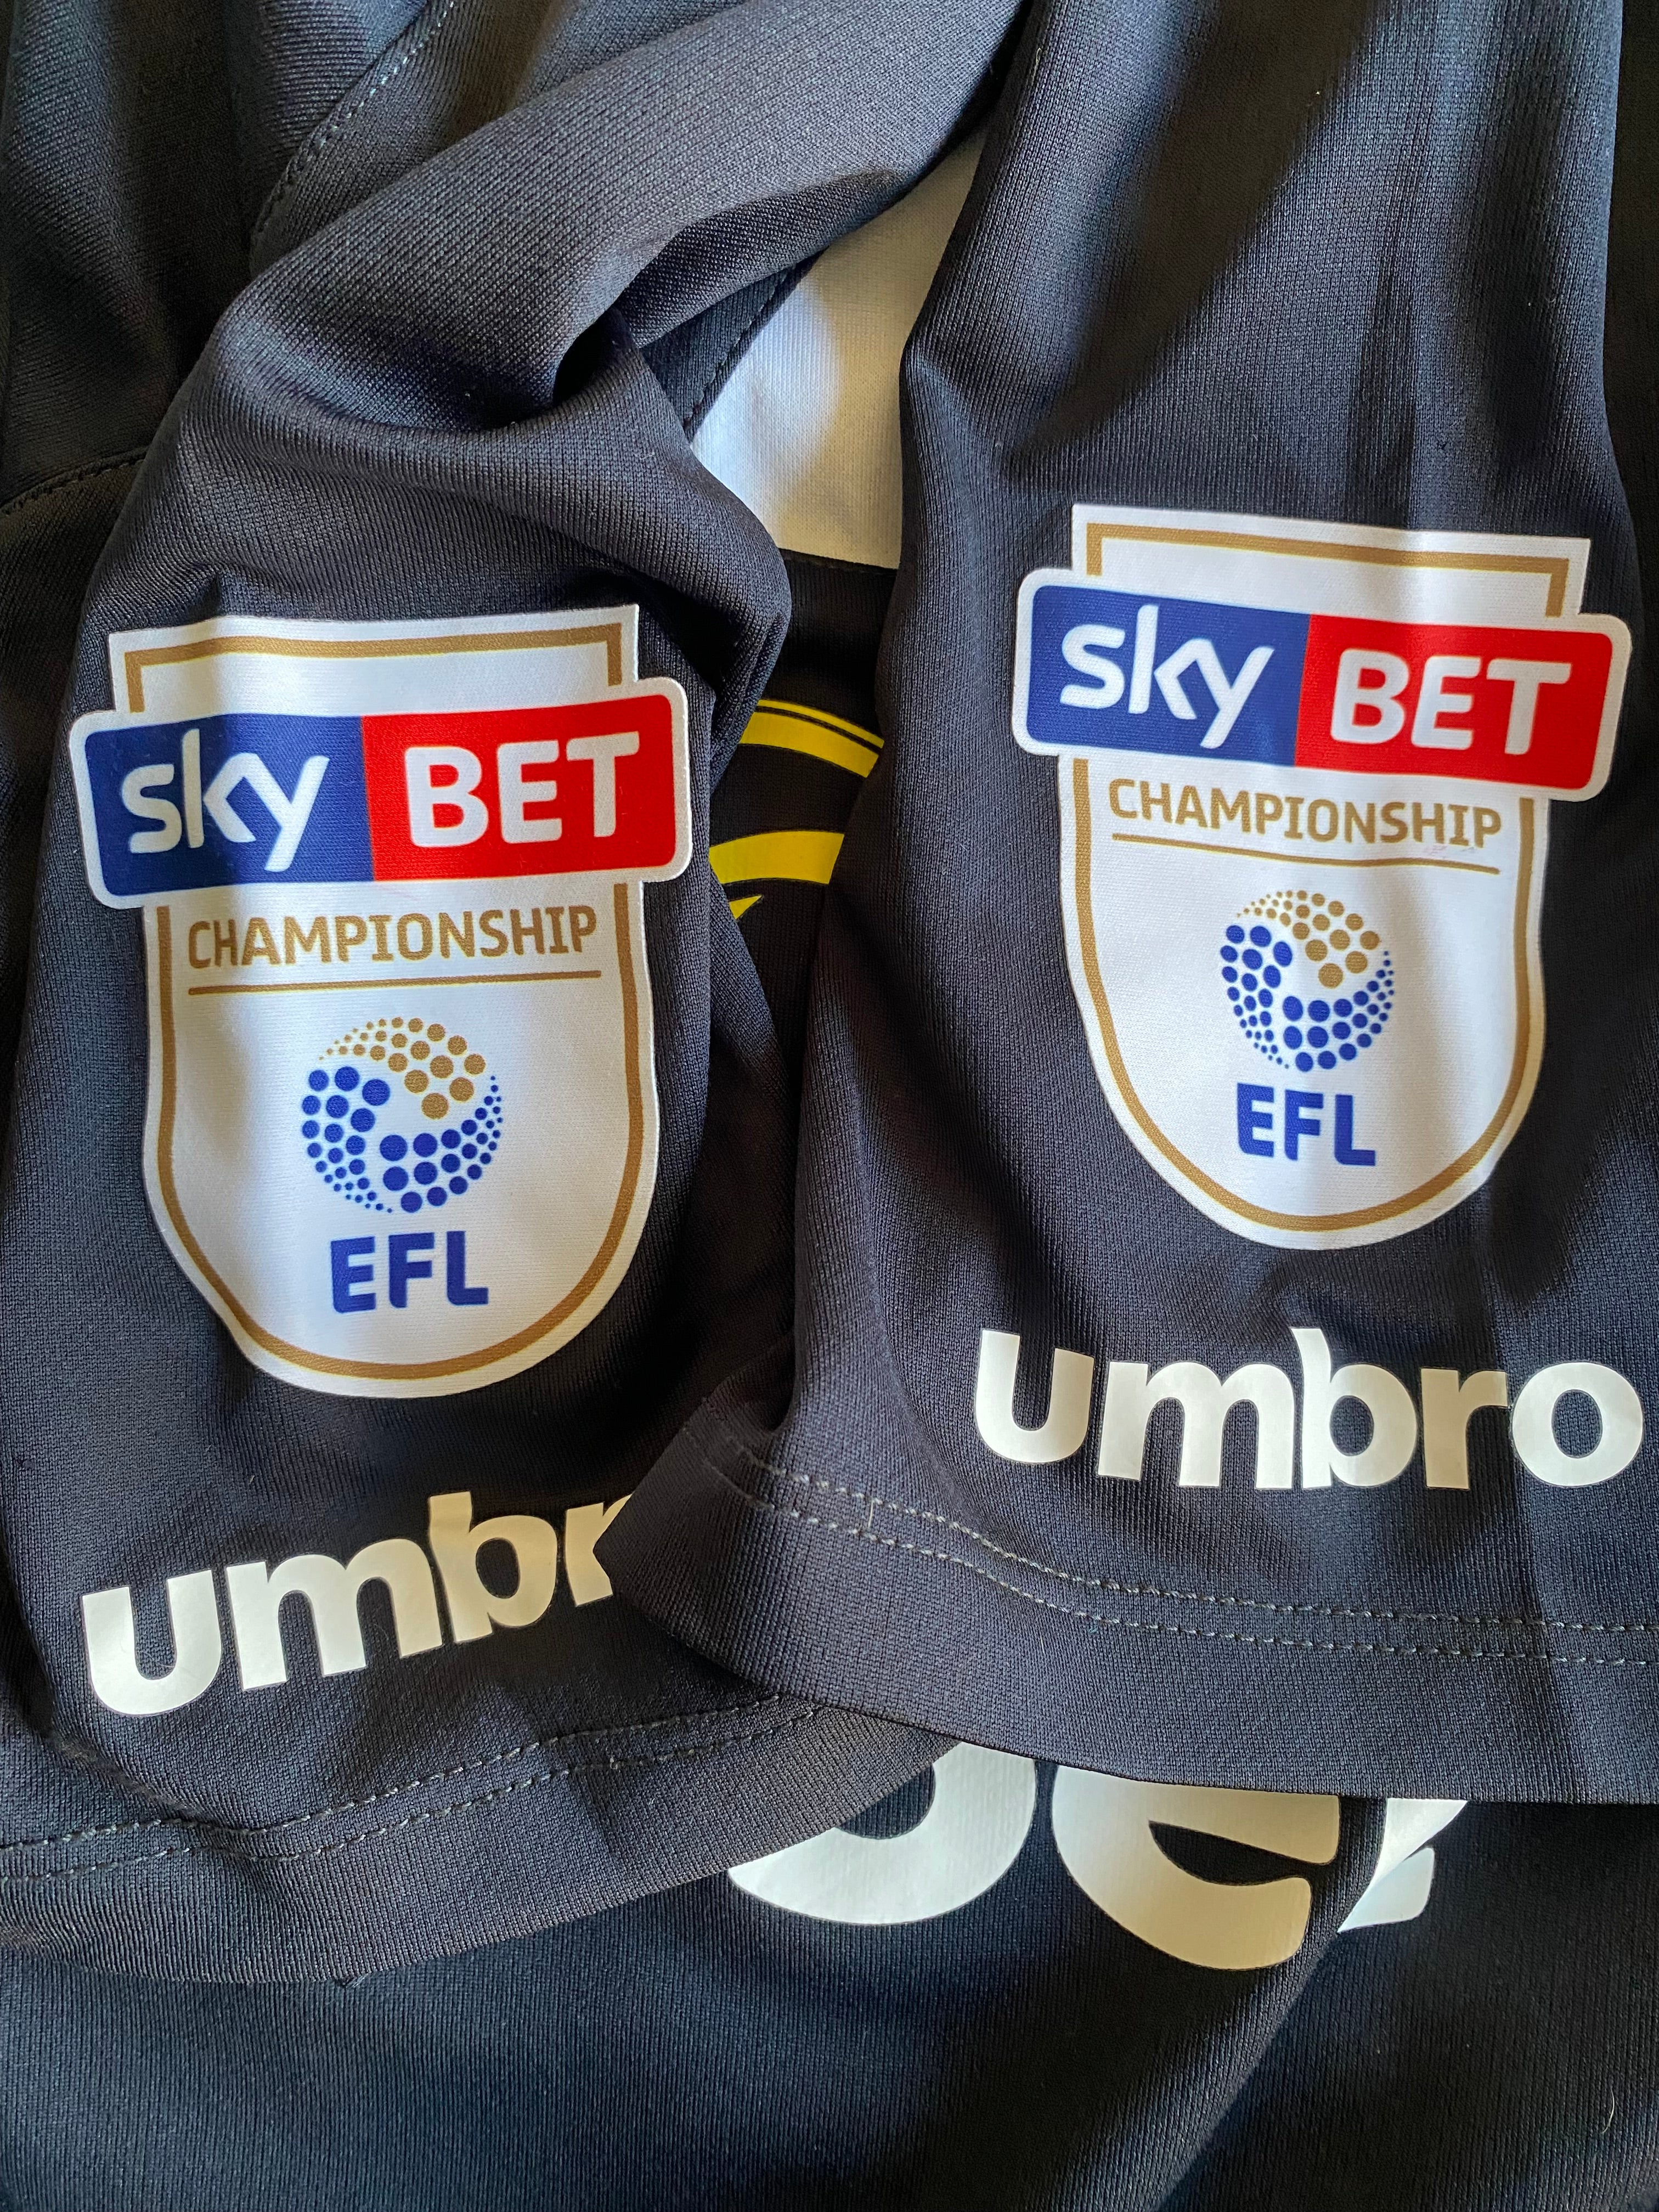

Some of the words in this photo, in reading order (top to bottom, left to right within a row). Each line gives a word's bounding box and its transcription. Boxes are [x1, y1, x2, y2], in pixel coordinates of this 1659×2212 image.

[1060, 605, 1274, 748] sky
[1330, 647, 1571, 755] BET
[121, 728, 330, 872] sky
[404, 731, 640, 848] BET
[1108, 777, 1502, 849] CHAMPIONSHIP
[188, 905, 597, 969] CHAMPIONSHIP
[1237, 1082, 1376, 1166] EFL
[330, 1231, 489, 1314] EFL
[974, 1327, 1644, 1490] umbro
